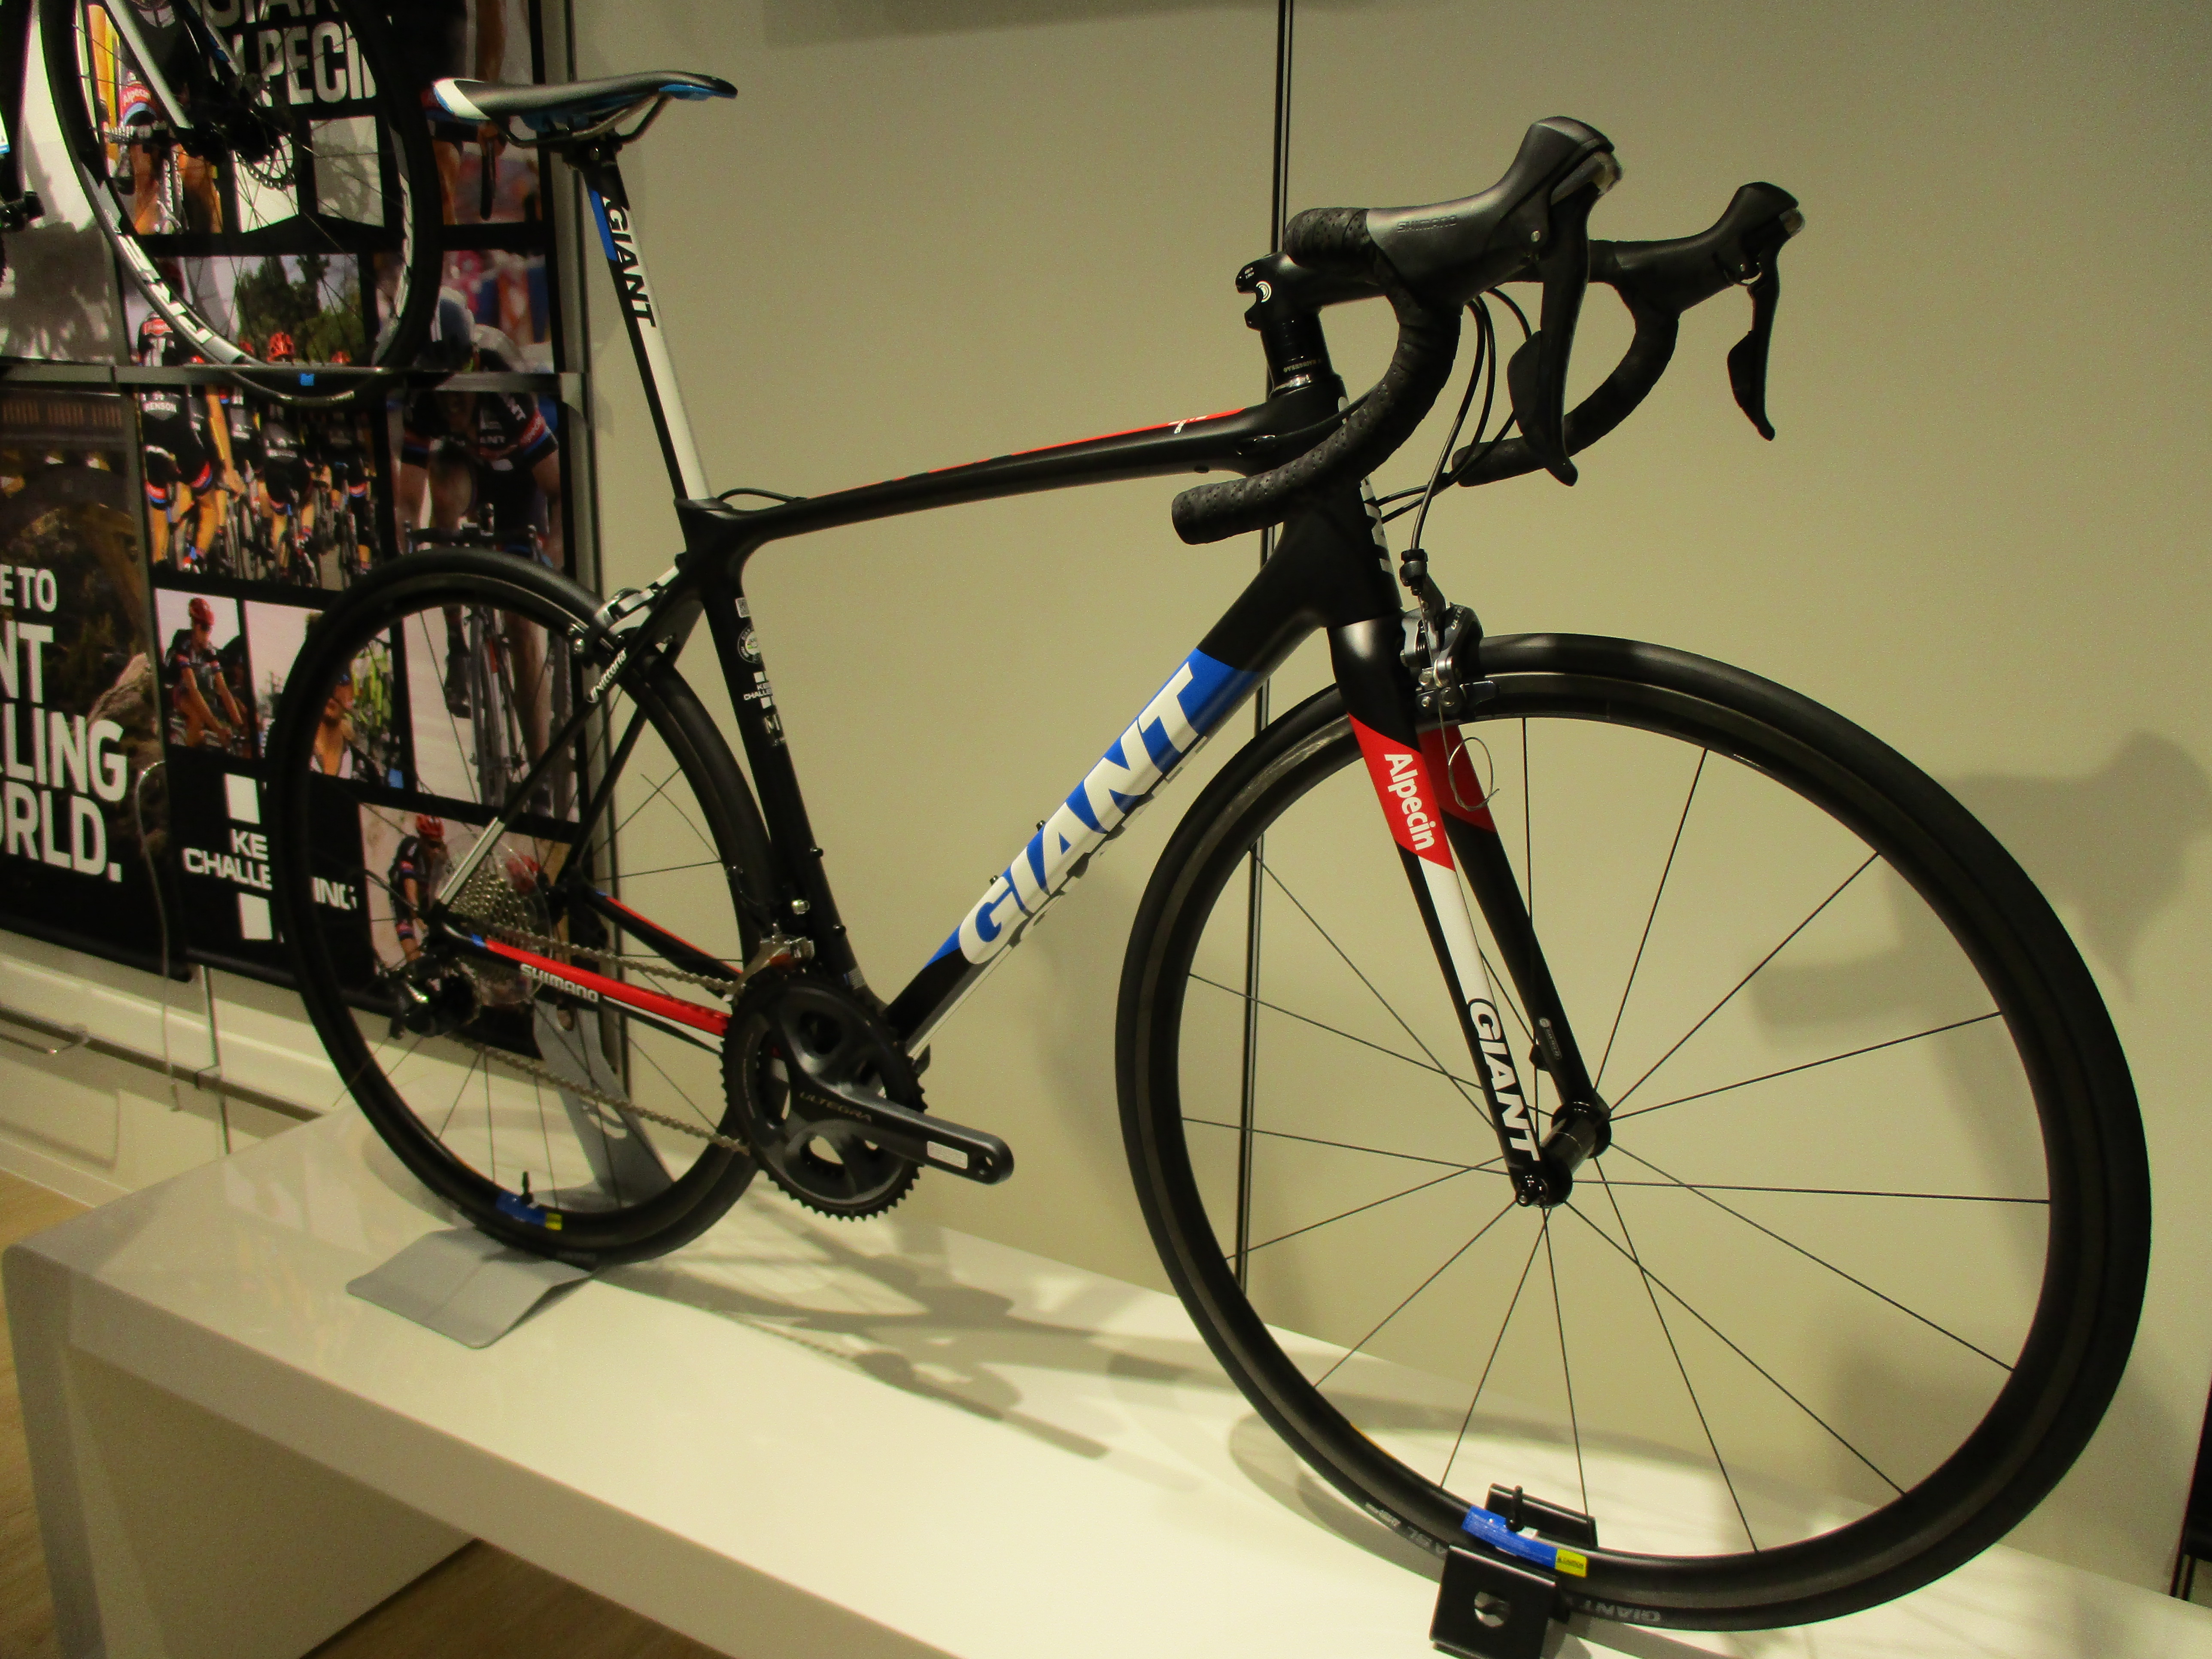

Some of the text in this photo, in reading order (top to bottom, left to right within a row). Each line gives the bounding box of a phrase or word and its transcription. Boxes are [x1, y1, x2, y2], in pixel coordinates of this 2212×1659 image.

[605, 200, 657, 328] GIANT
[16, 567, 57, 613] TO
[0, 702, 128, 802] LING
[1384, 754, 1436, 851] Alpecin
[0, 781, 122, 882] RLD.
[959, 661, 1201, 964] GIANT
[1468, 999, 1541, 1161] GIANT
